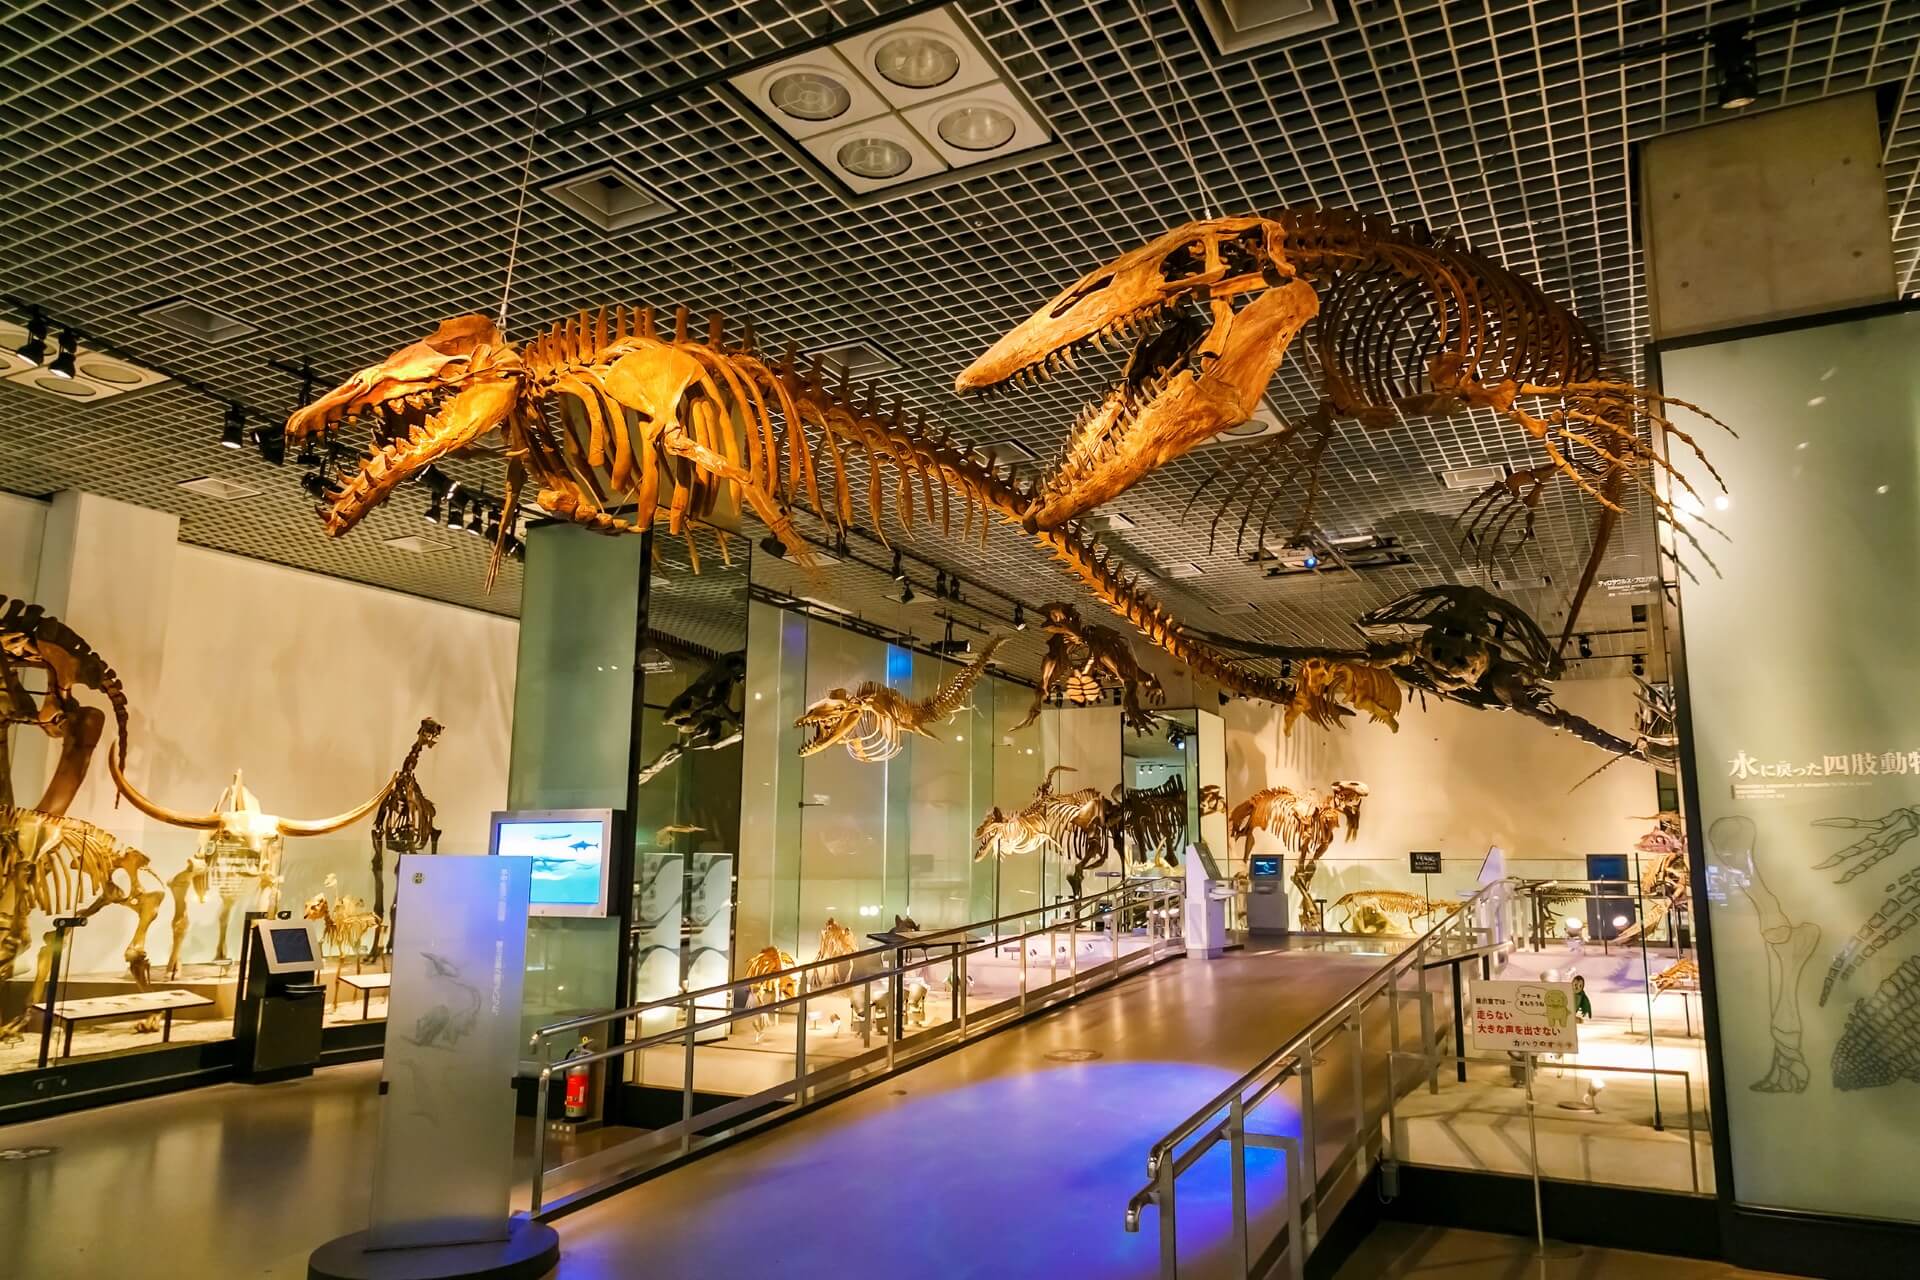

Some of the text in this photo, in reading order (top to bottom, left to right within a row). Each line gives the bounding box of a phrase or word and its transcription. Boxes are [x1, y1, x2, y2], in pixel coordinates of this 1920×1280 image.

[1476, 1009, 1513, 1020] 走らない
[1477, 1024, 1561, 1036] 大きな声を出さない
